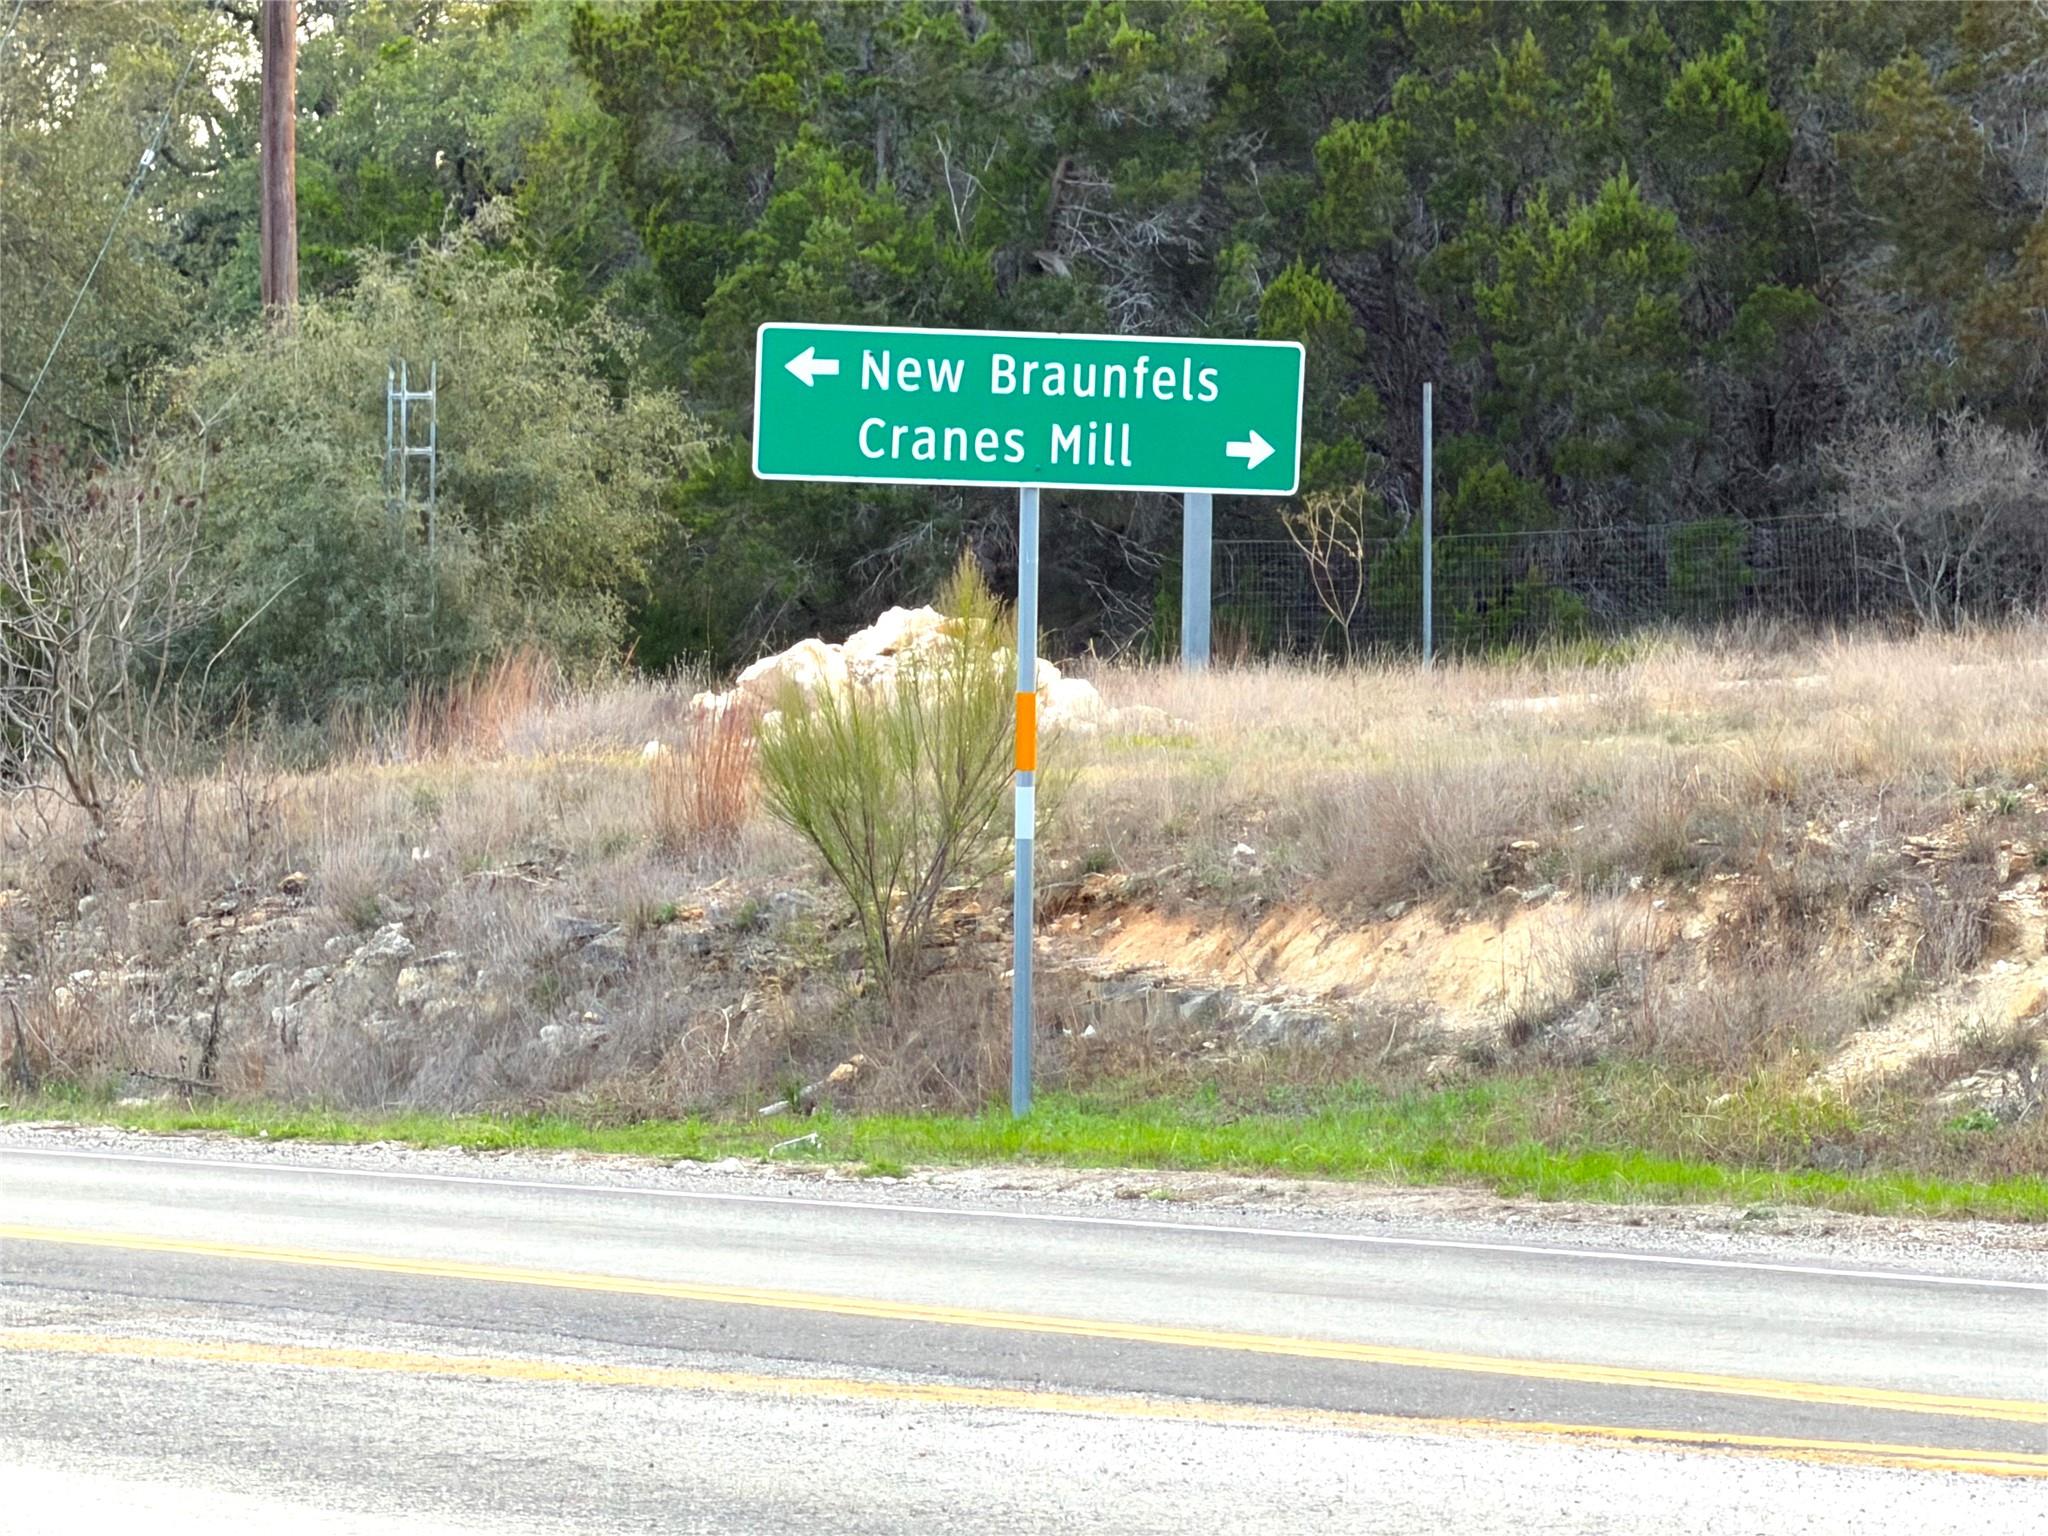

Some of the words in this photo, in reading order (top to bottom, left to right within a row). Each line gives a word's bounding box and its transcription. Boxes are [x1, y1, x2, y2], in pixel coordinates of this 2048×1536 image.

[861, 350, 965, 393] New
[991, 353, 1219, 402] Braunfels
[859, 417, 1025, 463] Cranes
[1051, 423, 1131, 467] Mill
